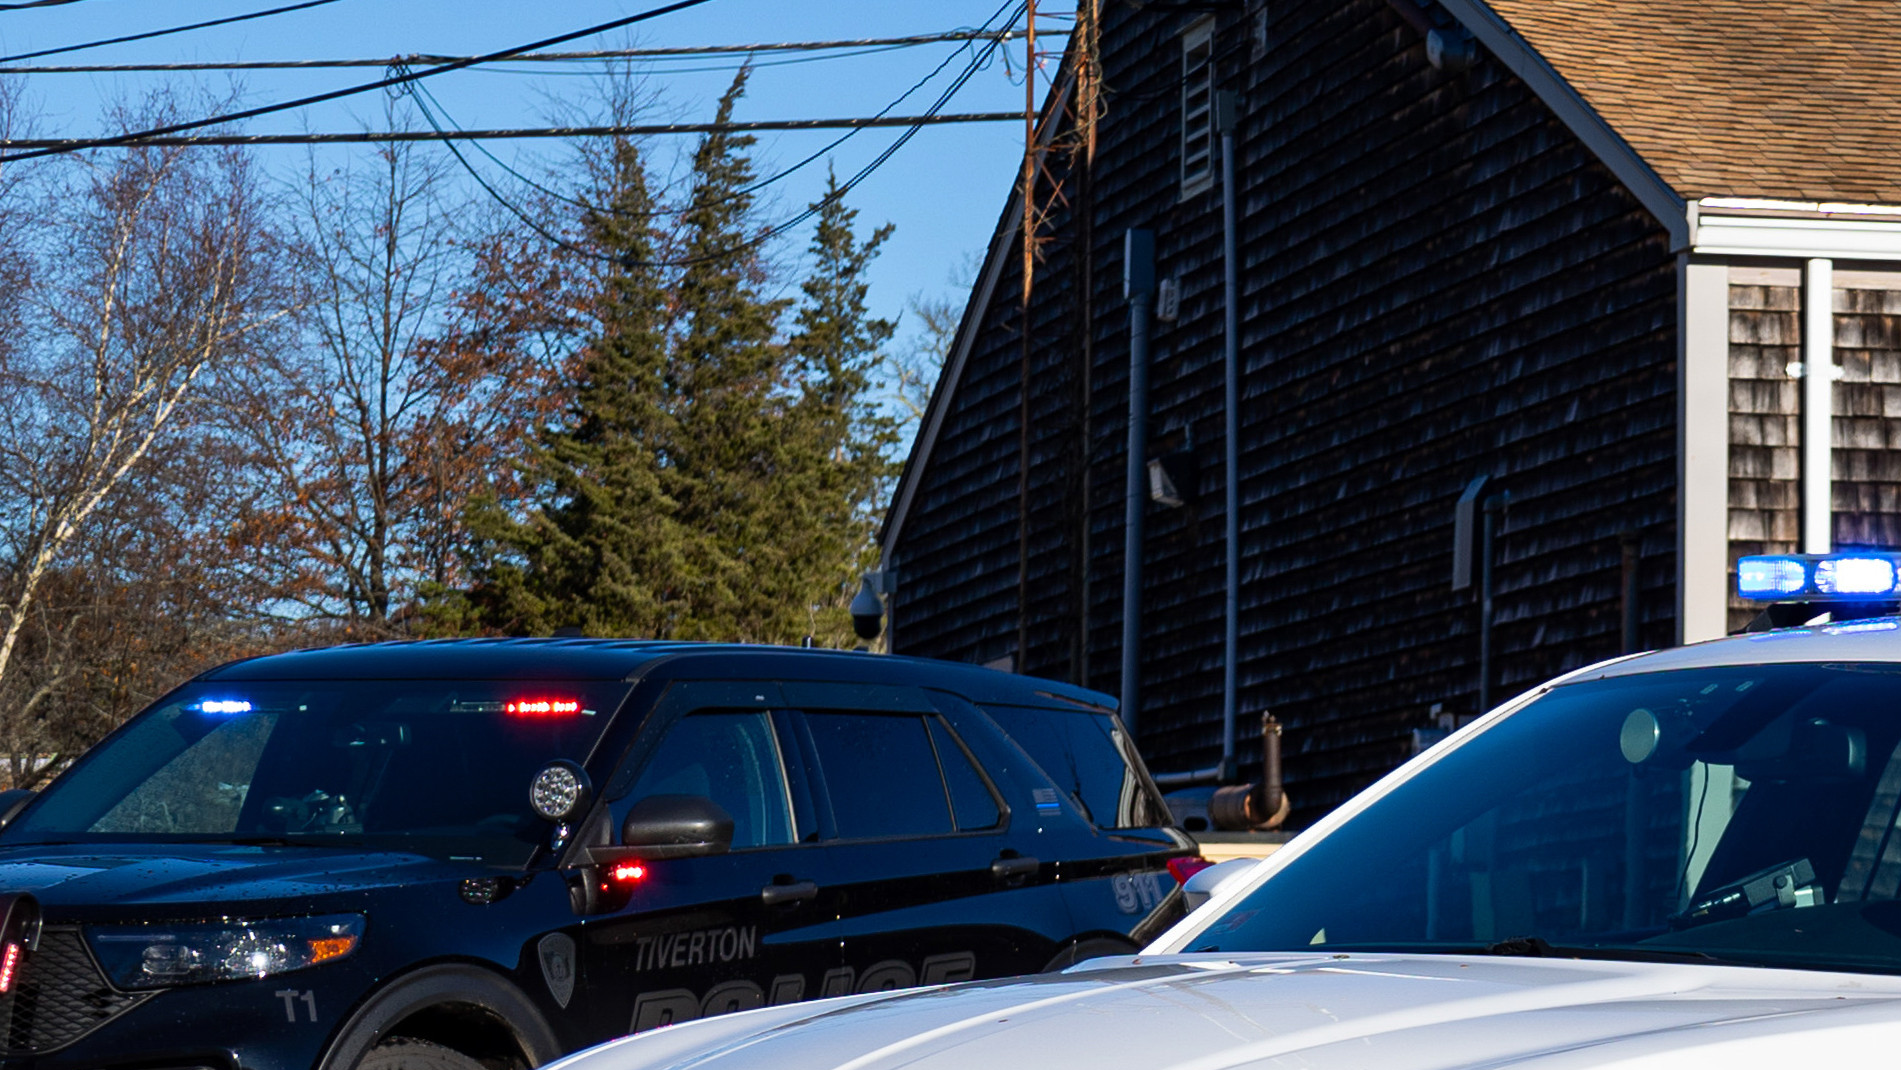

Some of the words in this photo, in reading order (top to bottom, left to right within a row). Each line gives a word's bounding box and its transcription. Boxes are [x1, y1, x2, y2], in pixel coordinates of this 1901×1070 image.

[1111, 872, 1164, 914] 911
[634, 925, 757, 972] TIVERTON
[274, 989, 318, 1024] T1
